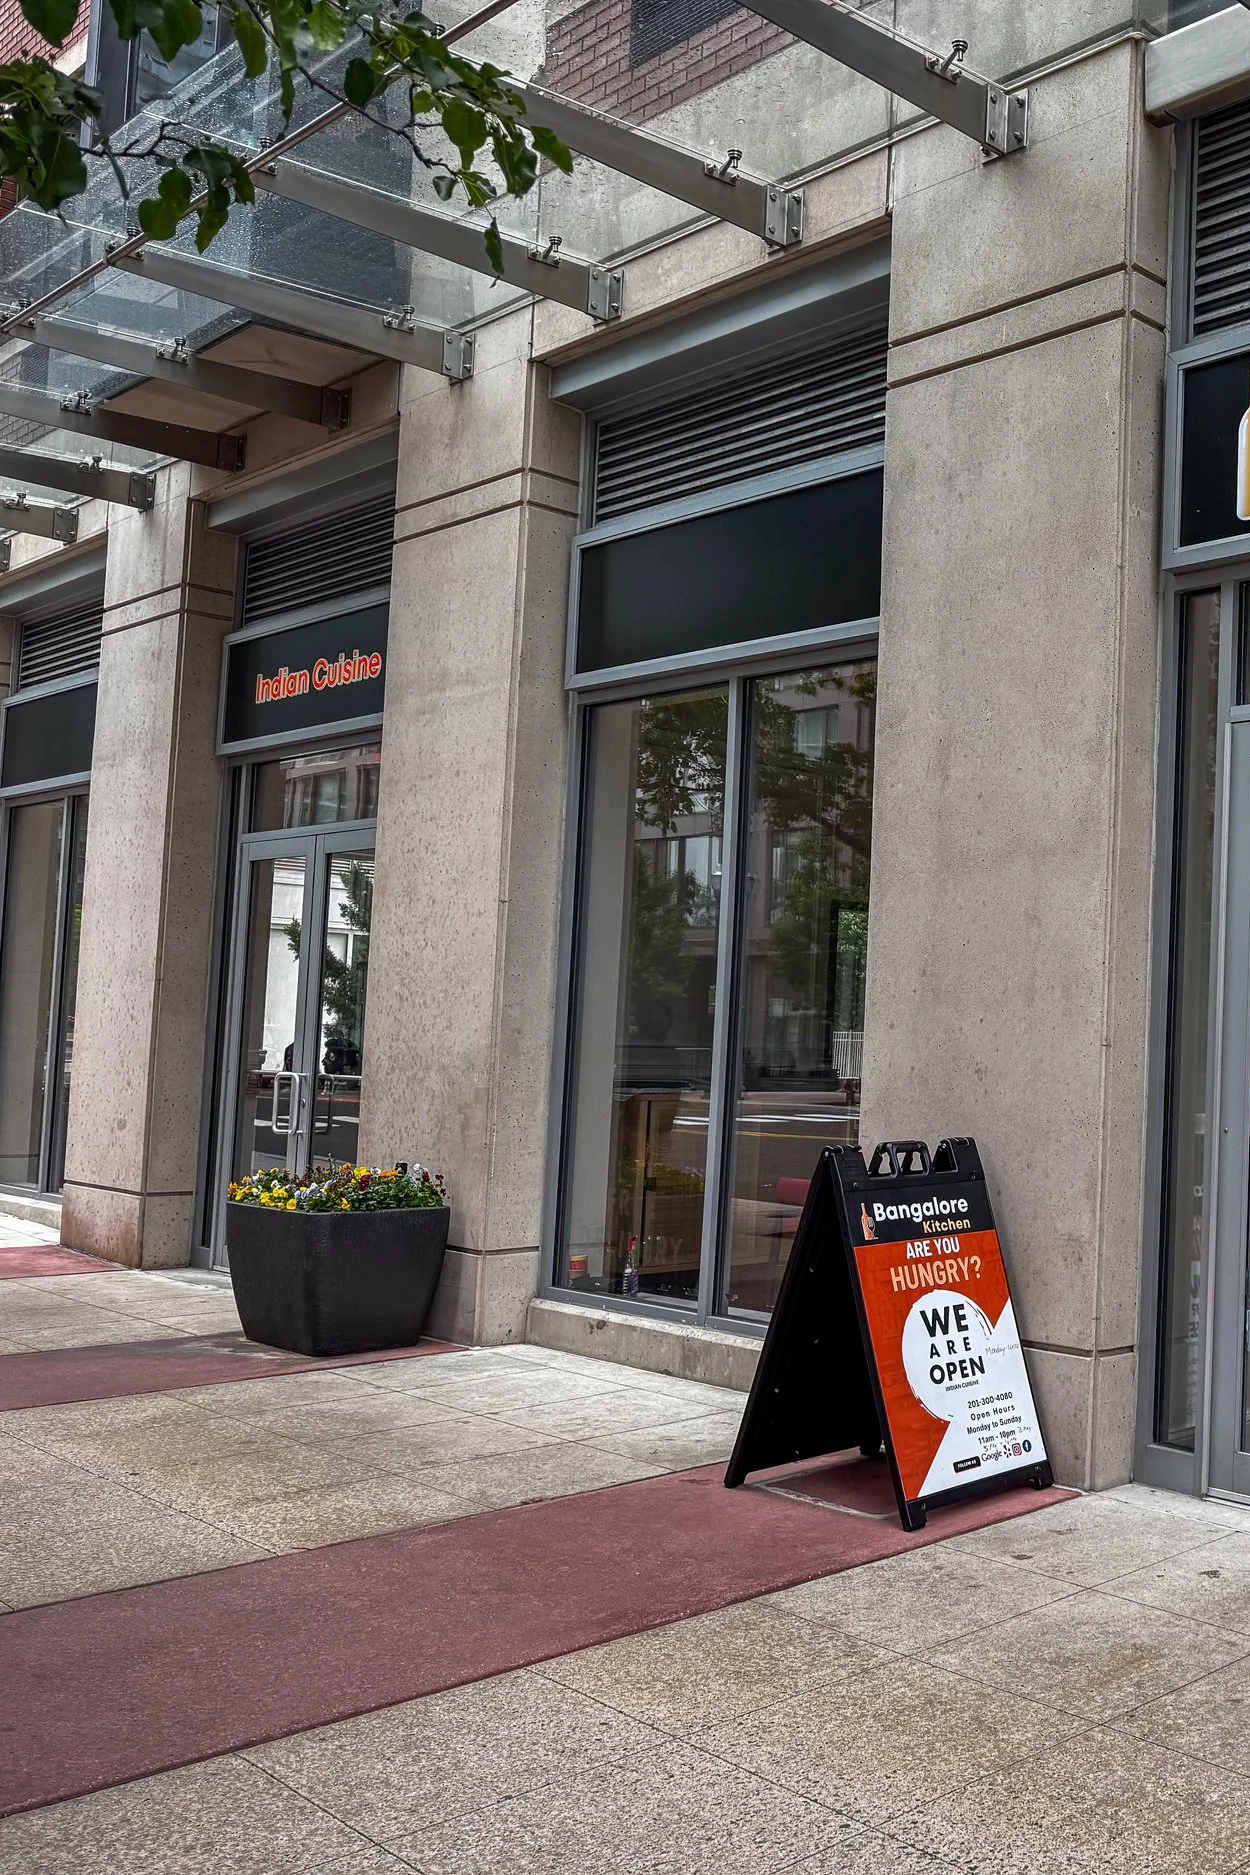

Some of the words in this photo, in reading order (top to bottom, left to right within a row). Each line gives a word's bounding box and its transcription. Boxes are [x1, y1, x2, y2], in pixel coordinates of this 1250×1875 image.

[254, 666, 311, 704] Indian
[312, 649, 383, 692] Cuisine
[872, 1196, 969, 1223] Bangalore
[922, 1218, 971, 1234] Kitchen
[906, 1239, 932, 1259] ARE
[933, 1236, 960, 1255] YOU
[889, 1255, 982, 1292] HUNGRY?
[919, 1303, 969, 1338] WE
[929, 1336, 972, 1359] ARE
[929, 1355, 986, 1385] OPEN
[967, 1391, 1013, 1409] 201-300-4080
[970, 1411, 990, 1422] Open
[992, 1404, 1016, 1416] Hours
[966, 1424, 991, 1435] Monday
[991, 1420, 999, 1428] to
[999, 1415, 1022, 1426] Sunday
[978, 1436, 995, 1444] 11am
[981, 1449, 1003, 1462] Google
